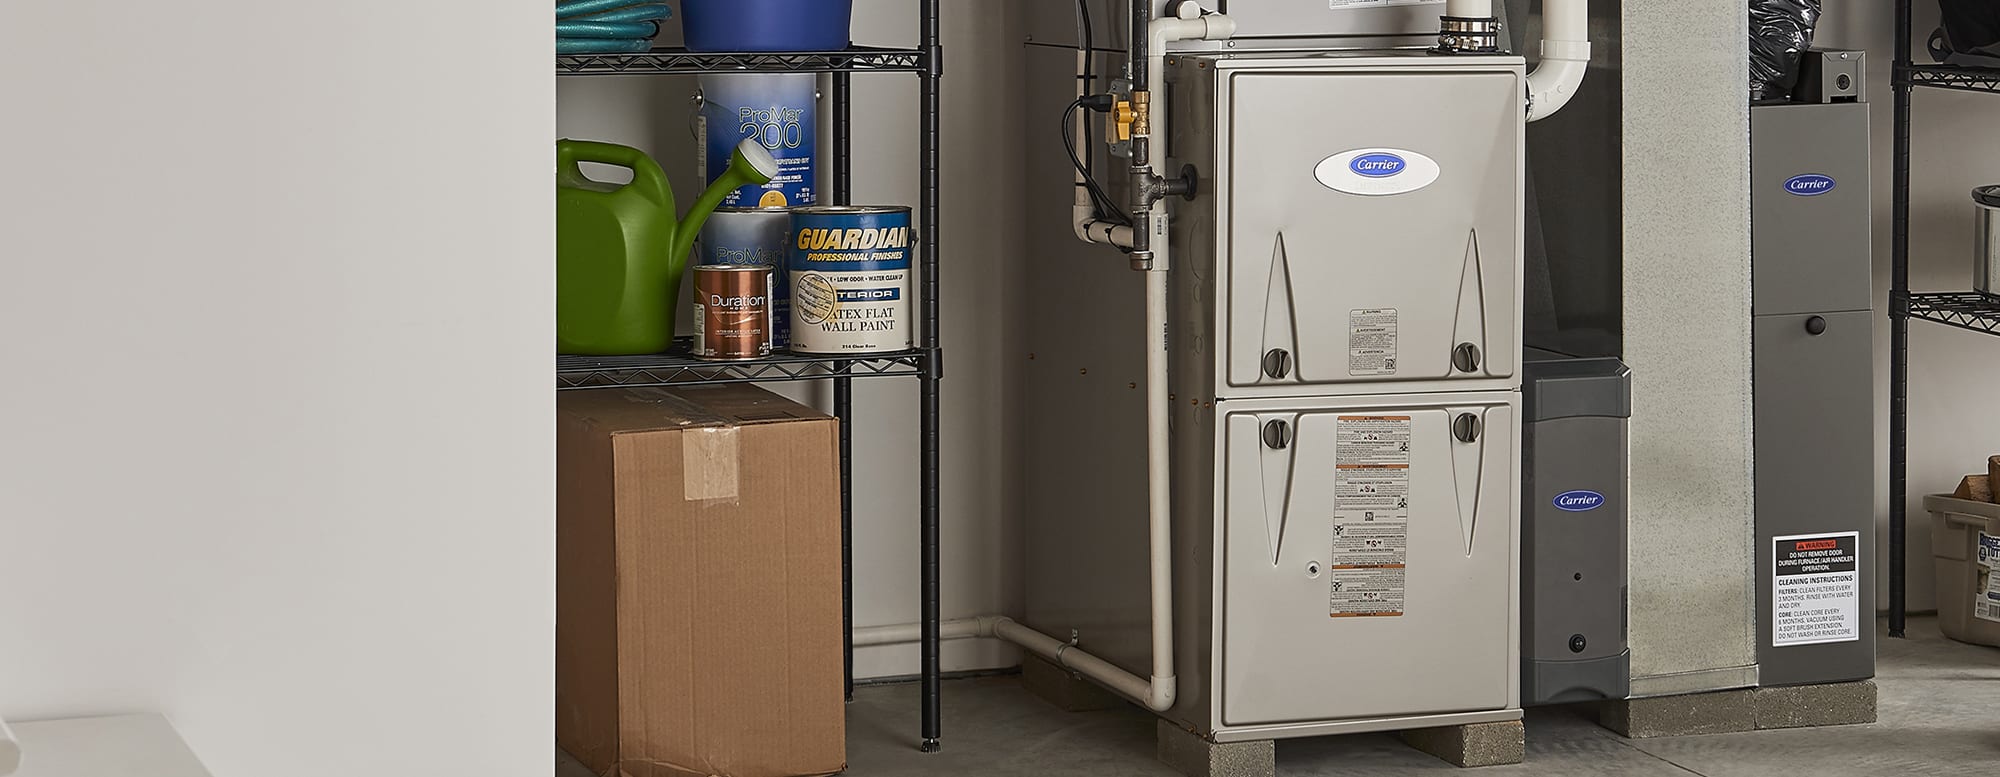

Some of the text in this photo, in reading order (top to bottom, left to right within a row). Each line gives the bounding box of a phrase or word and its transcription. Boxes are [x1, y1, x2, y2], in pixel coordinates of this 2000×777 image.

[739, 106, 802, 122] ProMar
[740, 121, 802, 149] 200
[1357, 159, 1399, 170] Carrier
[1791, 179, 1829, 189] Carrier
[797, 226, 909, 250] GUARDIAN
[717, 247, 777, 263] ProMar
[807, 251, 903, 261] PROFESSIONAL FINISHES
[711, 294, 764, 307] Duration
[837, 290, 893, 299] TERIOR
[831, 307, 895, 319] ATEX FLAT
[821, 320, 895, 332] WALL PAINT
[1560, 495, 1598, 505] Carrier
[1779, 574, 1853, 585] CLEANING INSTRUCTIONS
